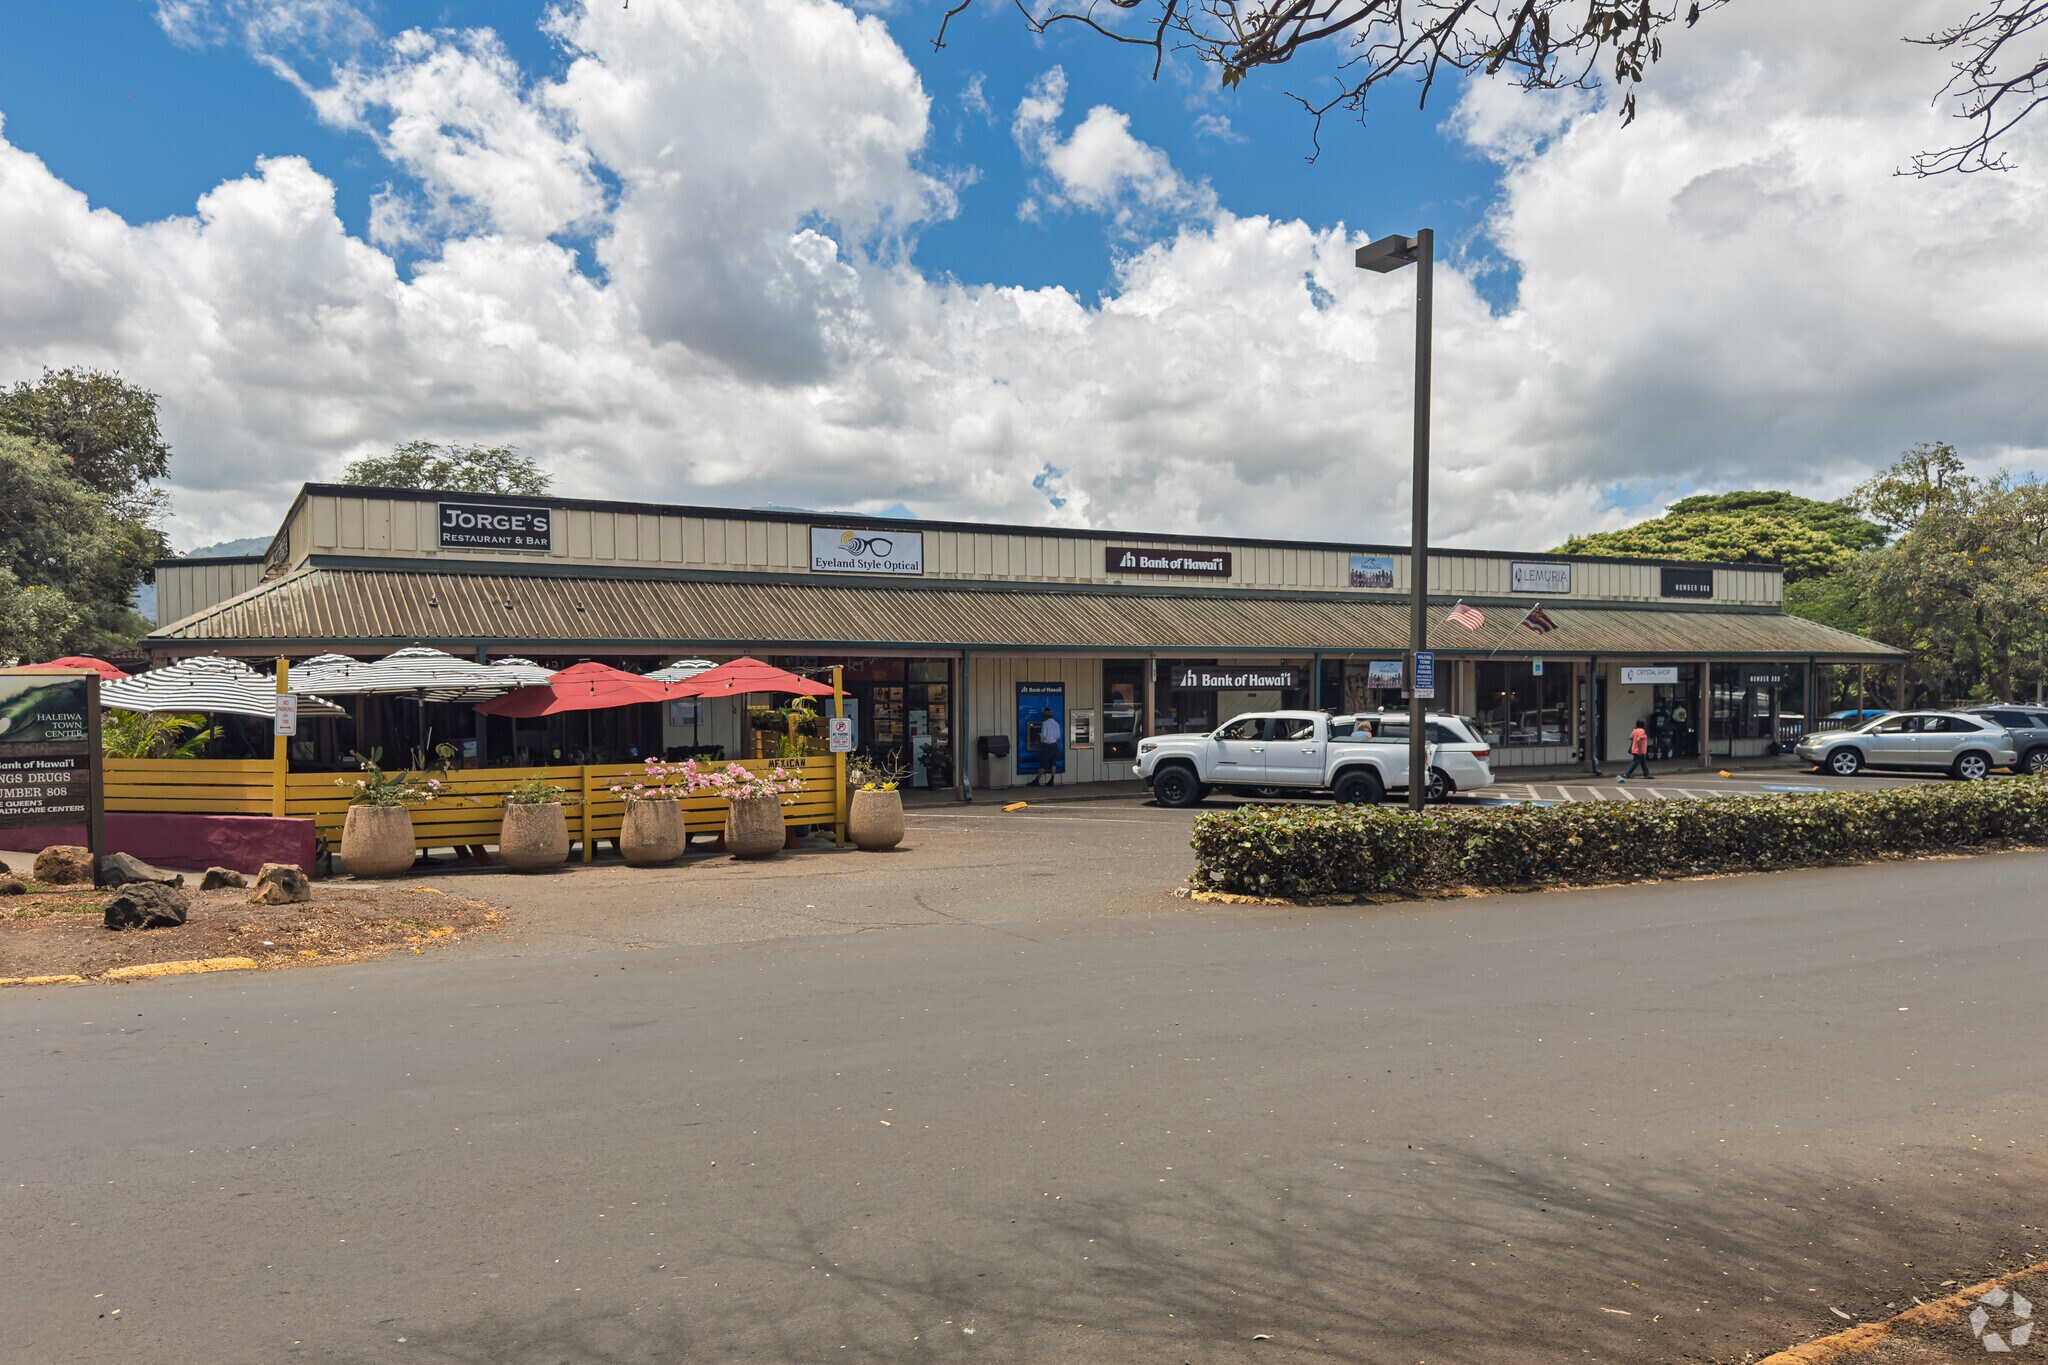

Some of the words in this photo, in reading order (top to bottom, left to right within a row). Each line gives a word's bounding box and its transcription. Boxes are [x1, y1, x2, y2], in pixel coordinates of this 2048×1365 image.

[443, 509, 548, 532] JORGE'S
[443, 533, 512, 544] RESTAURANT
[515, 536, 523, 545] &
[526, 537, 548, 546] BAR
[815, 557, 855, 569] Eyeland
[857, 559, 881, 570] Style
[884, 560, 919, 572] Optical
[1140, 556, 1169, 569] Bank
[1170, 558, 1183, 569] of
[1524, 569, 1568, 583] LEMURIA
[1201, 673, 1233, 687] Bank
[1234, 674, 1248, 687] of
[37, 713, 82, 721] HALEIWA
[52, 721, 82, 729] TOWN
[45, 730, 83, 738] CENTER
[0, 761, 22, 769] ank
[23, 760, 35, 769] of
[36, 758, 75, 768] Hawai'i
[768, 758, 806, 768] MEXICAN
[28, 772, 71, 783] DRUGS
[46, 787, 68, 797] 808
[5, 799, 43, 807] QUEEN'S
[22, 806, 46, 814] CARE
[47, 804, 85, 812] CENTERS
